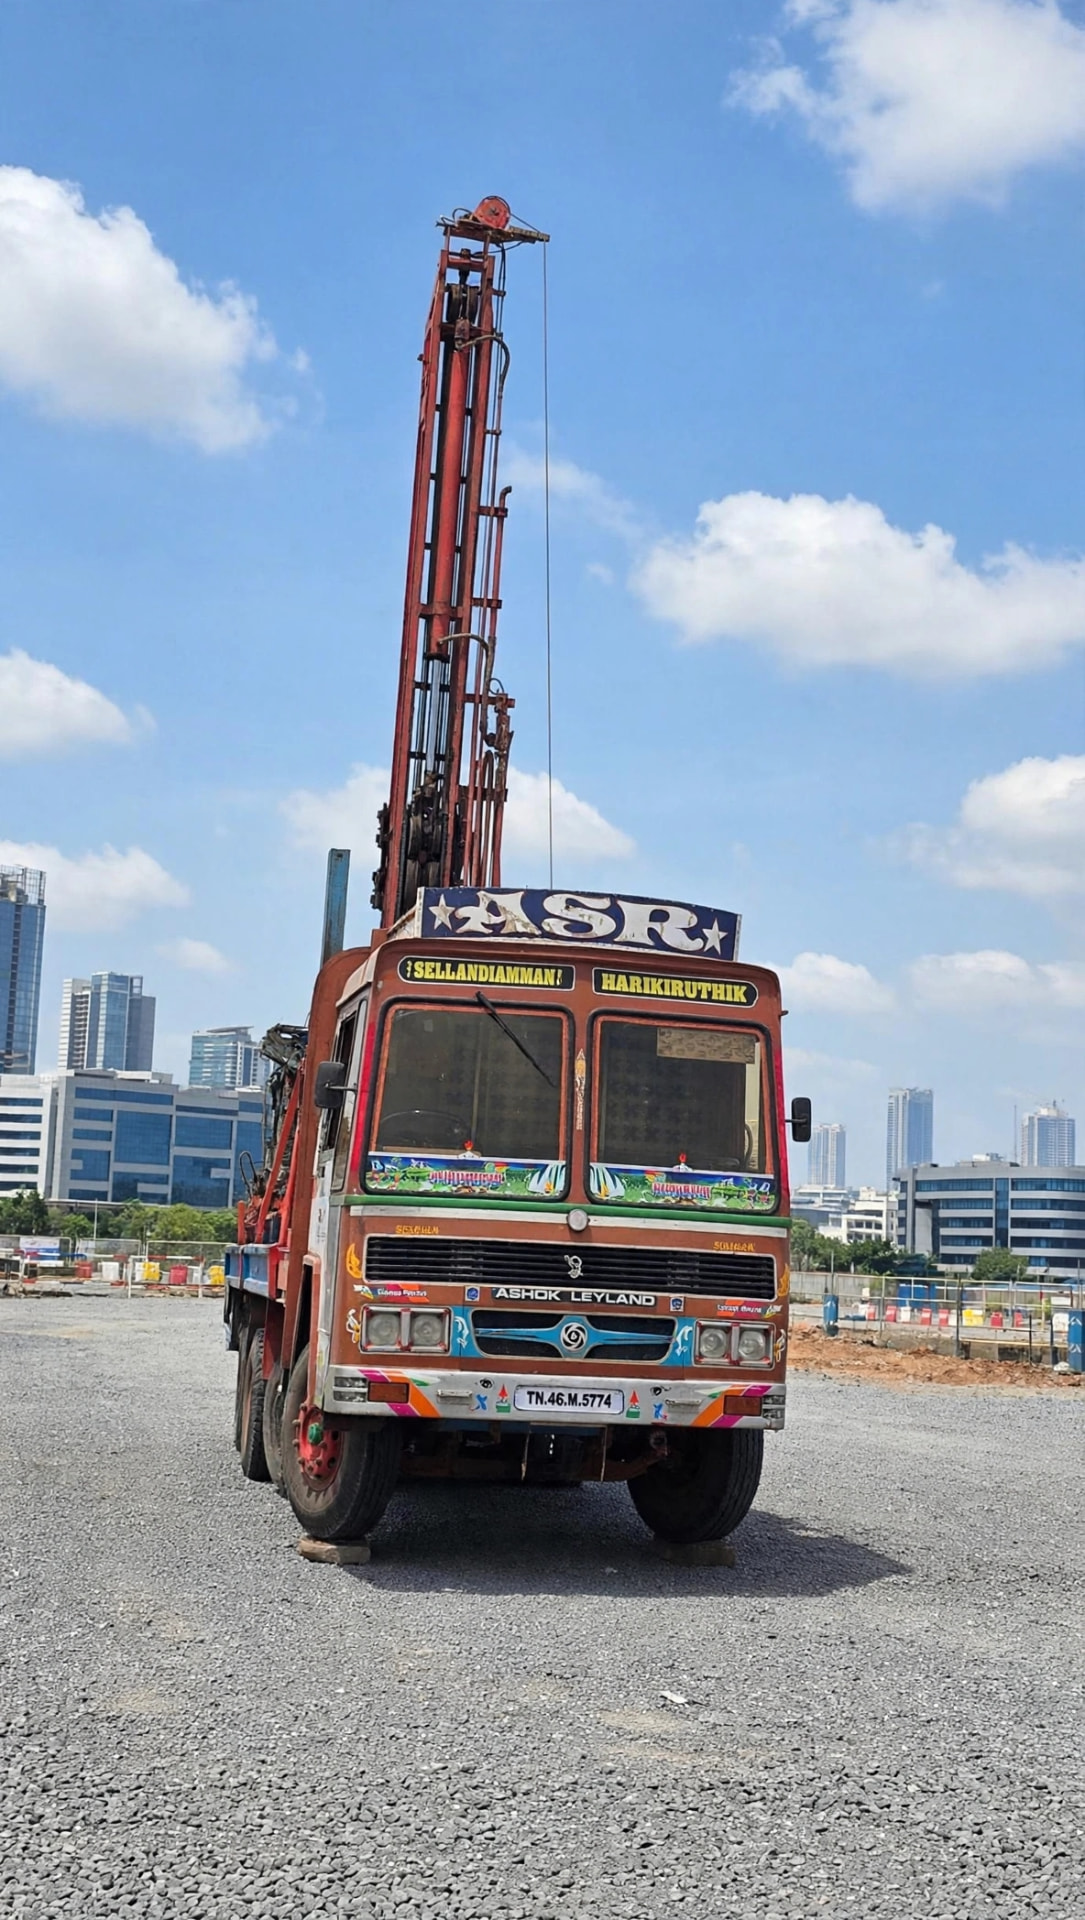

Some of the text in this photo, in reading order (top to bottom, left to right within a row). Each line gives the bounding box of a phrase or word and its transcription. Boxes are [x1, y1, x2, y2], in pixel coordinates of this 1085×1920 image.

[455, 890, 704, 951] ASR
[413, 960, 556, 986] SELLANDIAMMAN
[601, 972, 747, 1003] HARIKIRUTHIK
[495, 1287, 655, 1306] ASHOK LEYLAND
[526, 1390, 612, 1409] TN.46.M.5774
